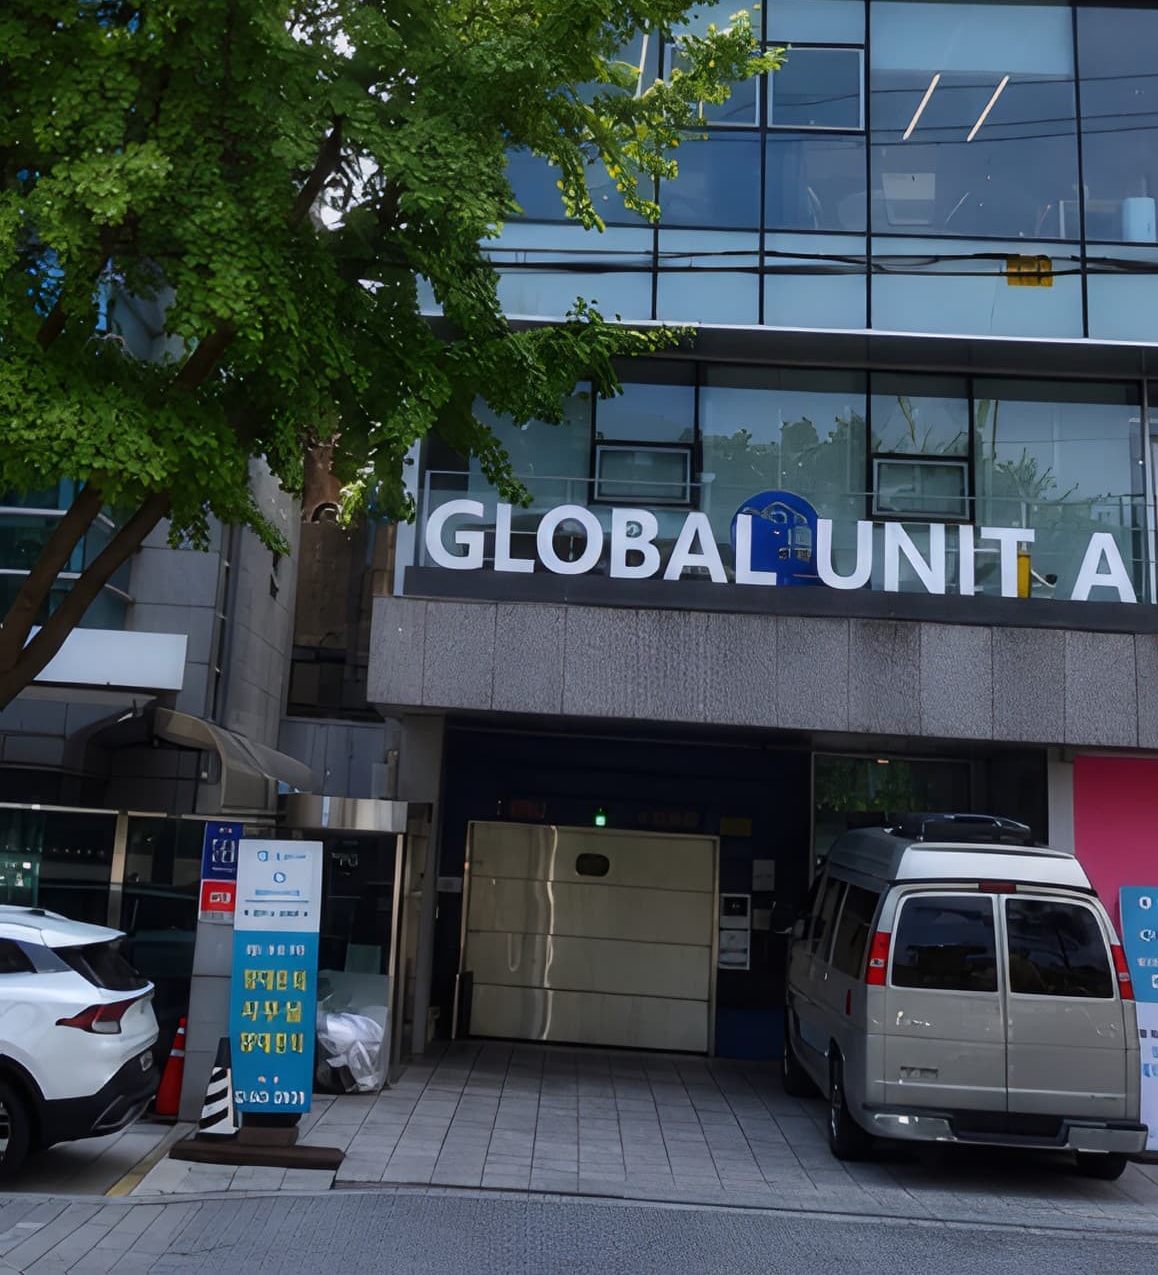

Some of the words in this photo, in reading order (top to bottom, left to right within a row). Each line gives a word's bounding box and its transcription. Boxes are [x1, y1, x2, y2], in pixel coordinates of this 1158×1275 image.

[425, 499, 777, 585] GLOBAL
[816, 518, 1035, 598] UNIT
[1071, 532, 1137, 603] A
